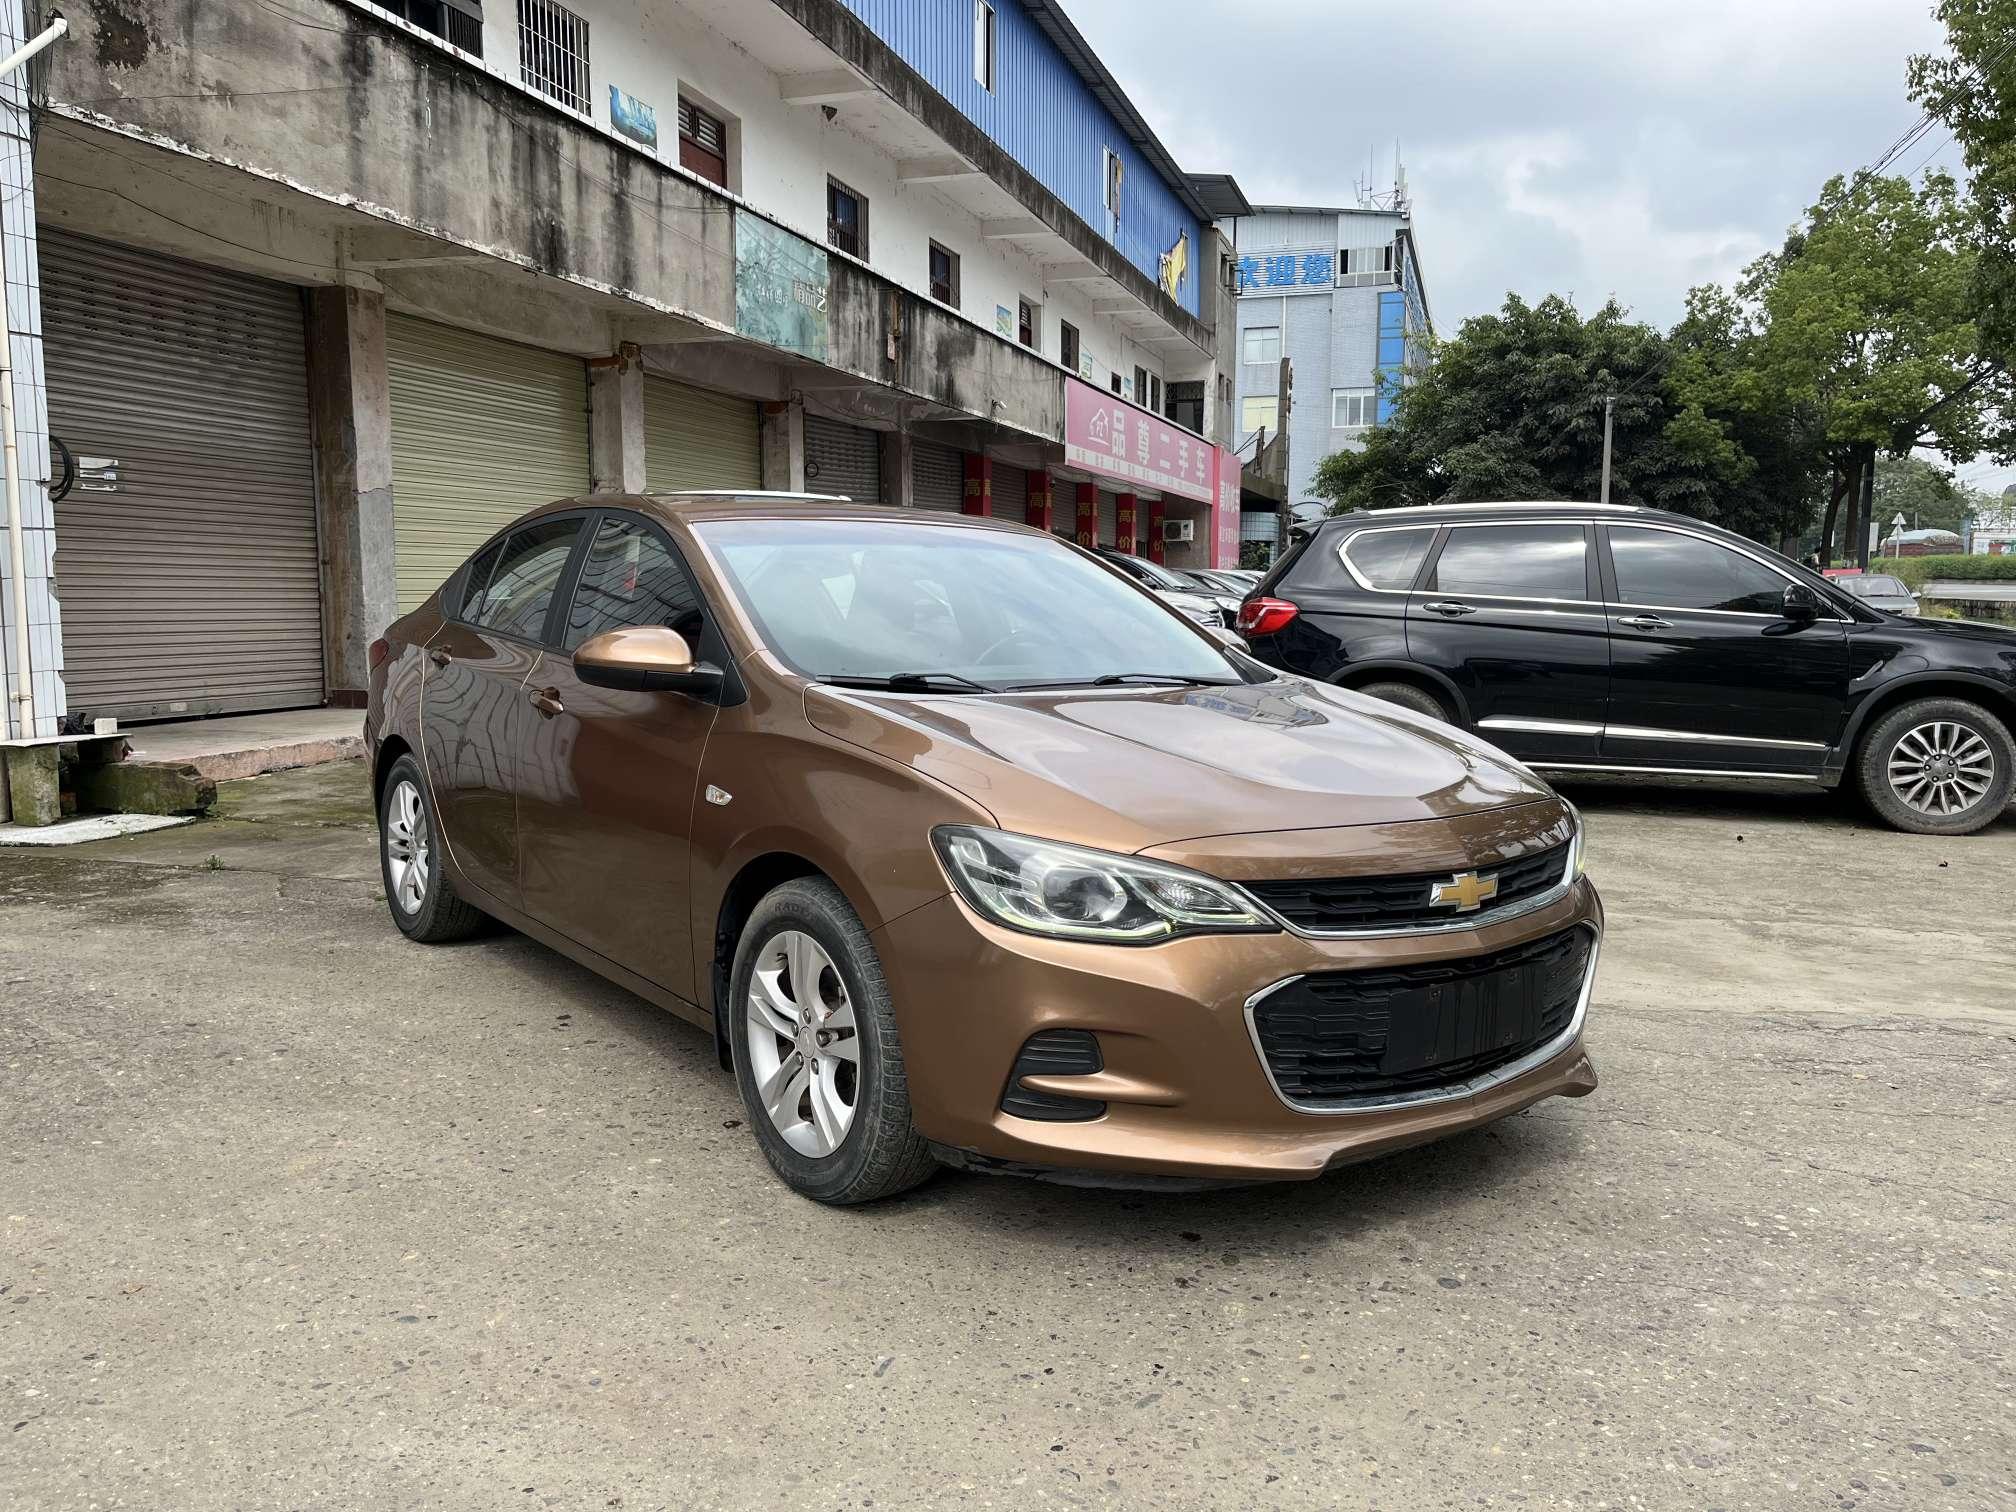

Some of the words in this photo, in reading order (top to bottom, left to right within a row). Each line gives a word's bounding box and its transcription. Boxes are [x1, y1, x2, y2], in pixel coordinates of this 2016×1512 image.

[1112, 408, 1205, 485] 品尊二手车
